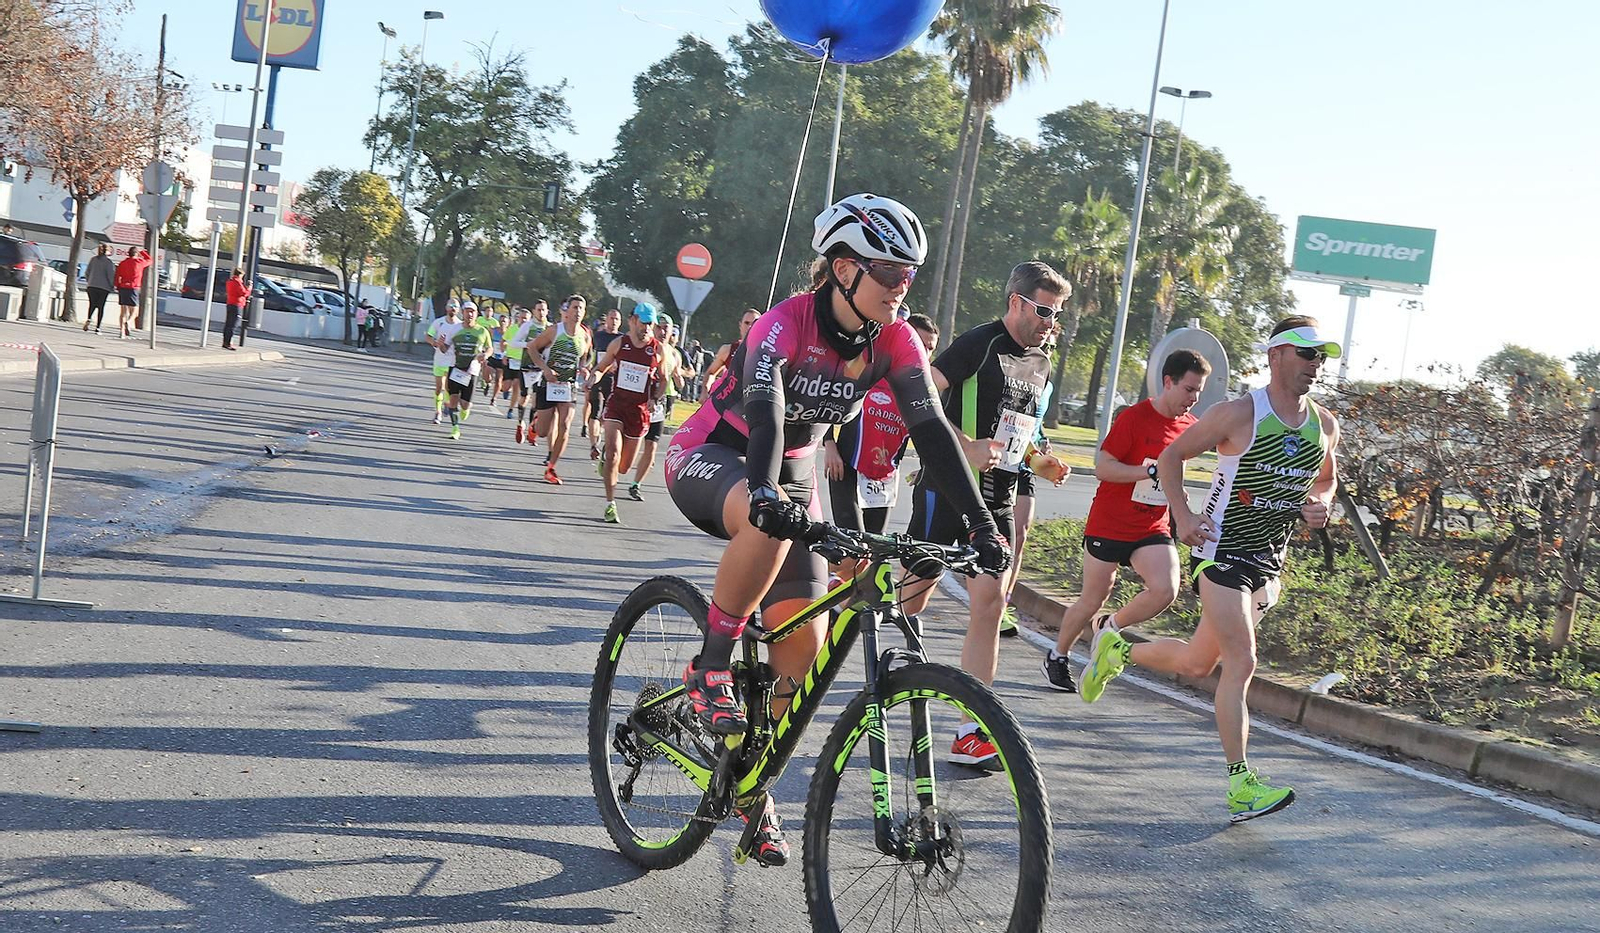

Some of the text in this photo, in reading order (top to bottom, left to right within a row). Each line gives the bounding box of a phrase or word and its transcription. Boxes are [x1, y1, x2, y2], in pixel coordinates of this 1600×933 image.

[1304, 232, 1425, 262] Sprinter
[624, 373, 640, 383] 303
[788, 369, 855, 400] indeso
[678, 452, 723, 481] Jerez
[1274, 467, 1286, 475] LA
[656, 744, 699, 781] SCOTT
[872, 782, 890, 819] FOX
